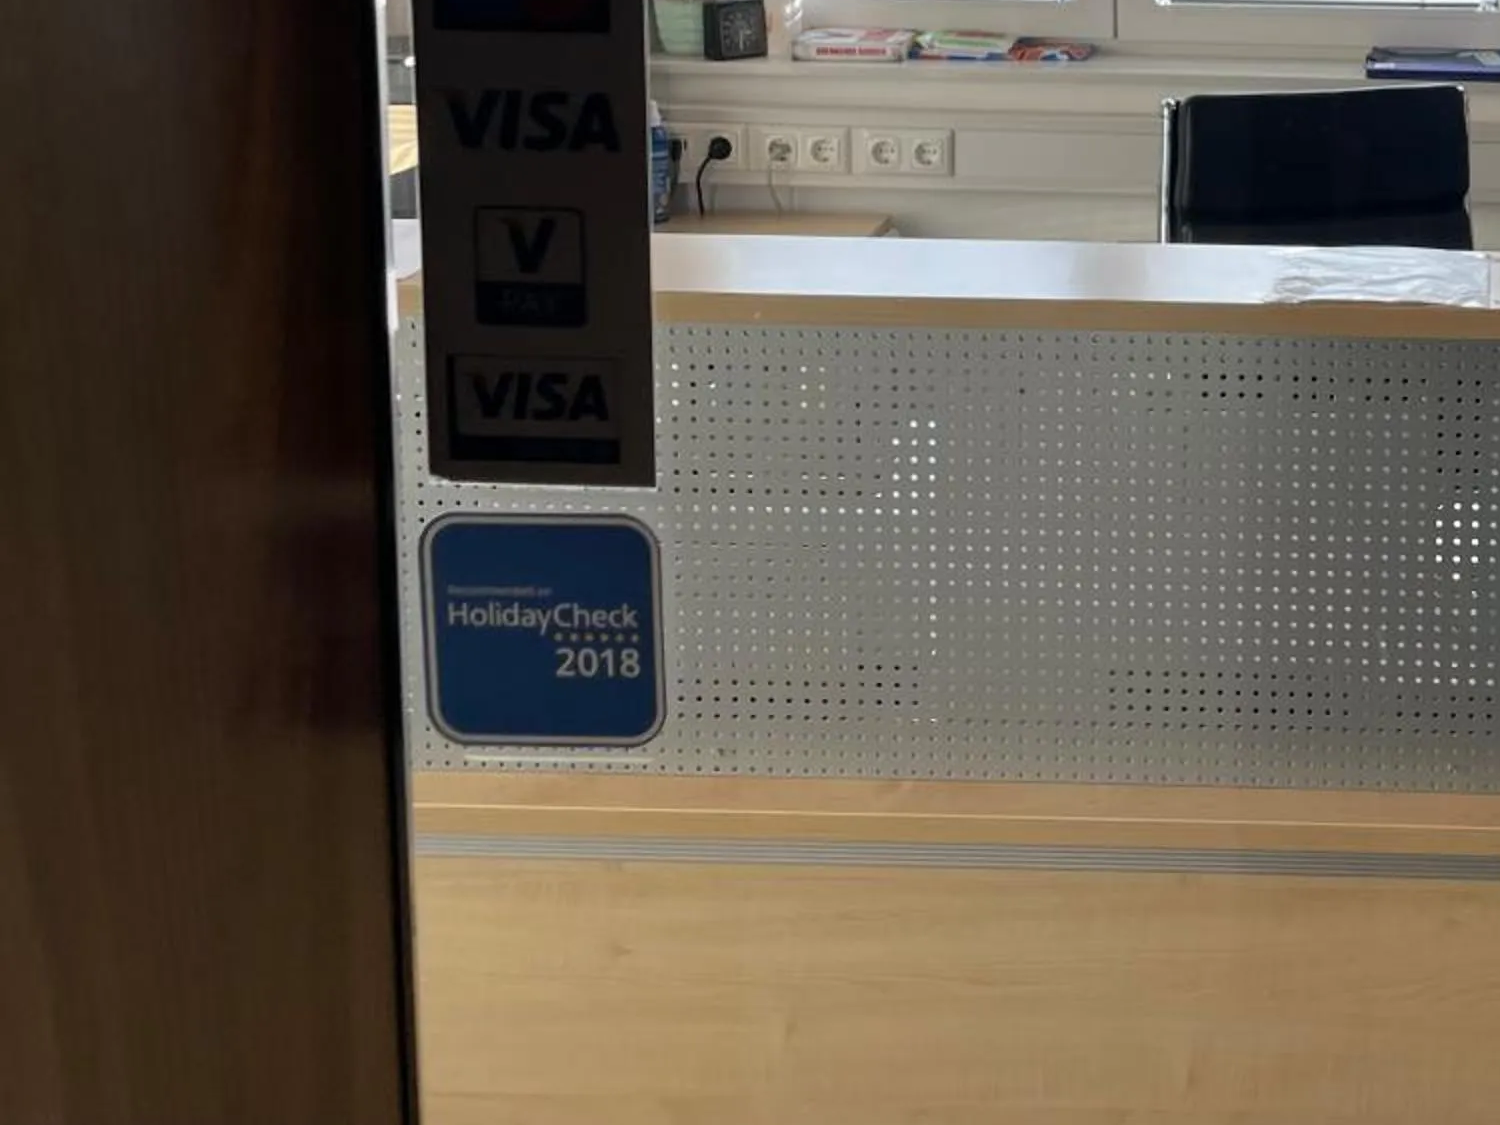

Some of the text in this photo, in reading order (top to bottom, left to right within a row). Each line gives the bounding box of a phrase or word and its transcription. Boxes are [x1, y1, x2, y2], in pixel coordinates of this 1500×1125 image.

[440, 89, 620, 153] VISA
[501, 219, 555, 274] V
[466, 372, 609, 422] VISA
[448, 601, 639, 636] HolidayCheck
[555, 647, 641, 679] 2018
